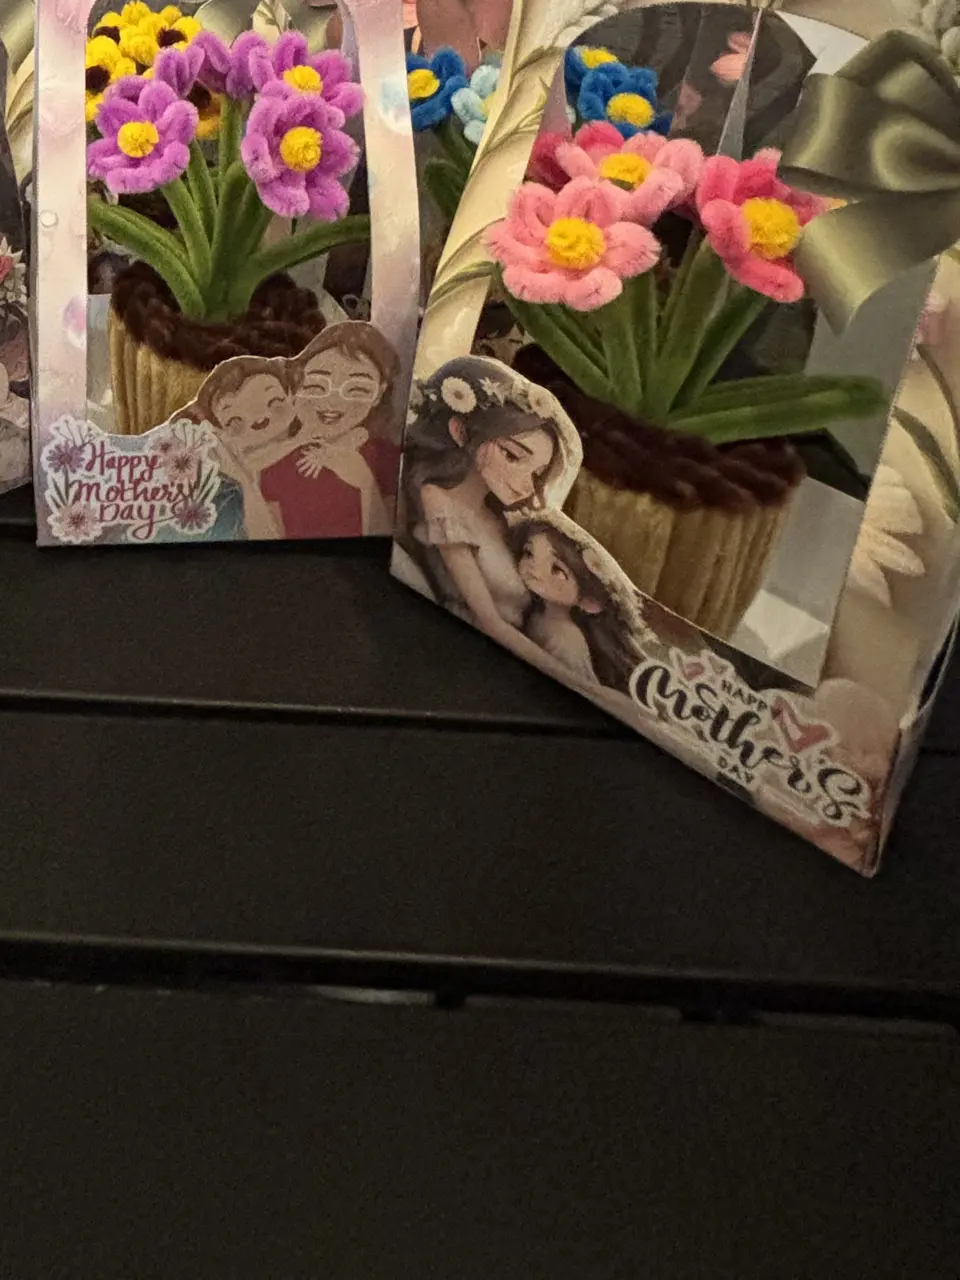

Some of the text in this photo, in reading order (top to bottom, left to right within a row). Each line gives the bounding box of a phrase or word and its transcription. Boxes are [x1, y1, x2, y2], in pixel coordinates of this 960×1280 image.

[81, 440, 161, 484] Happy
[99, 502, 158, 541] Day
[717, 755, 755, 784] DAY
